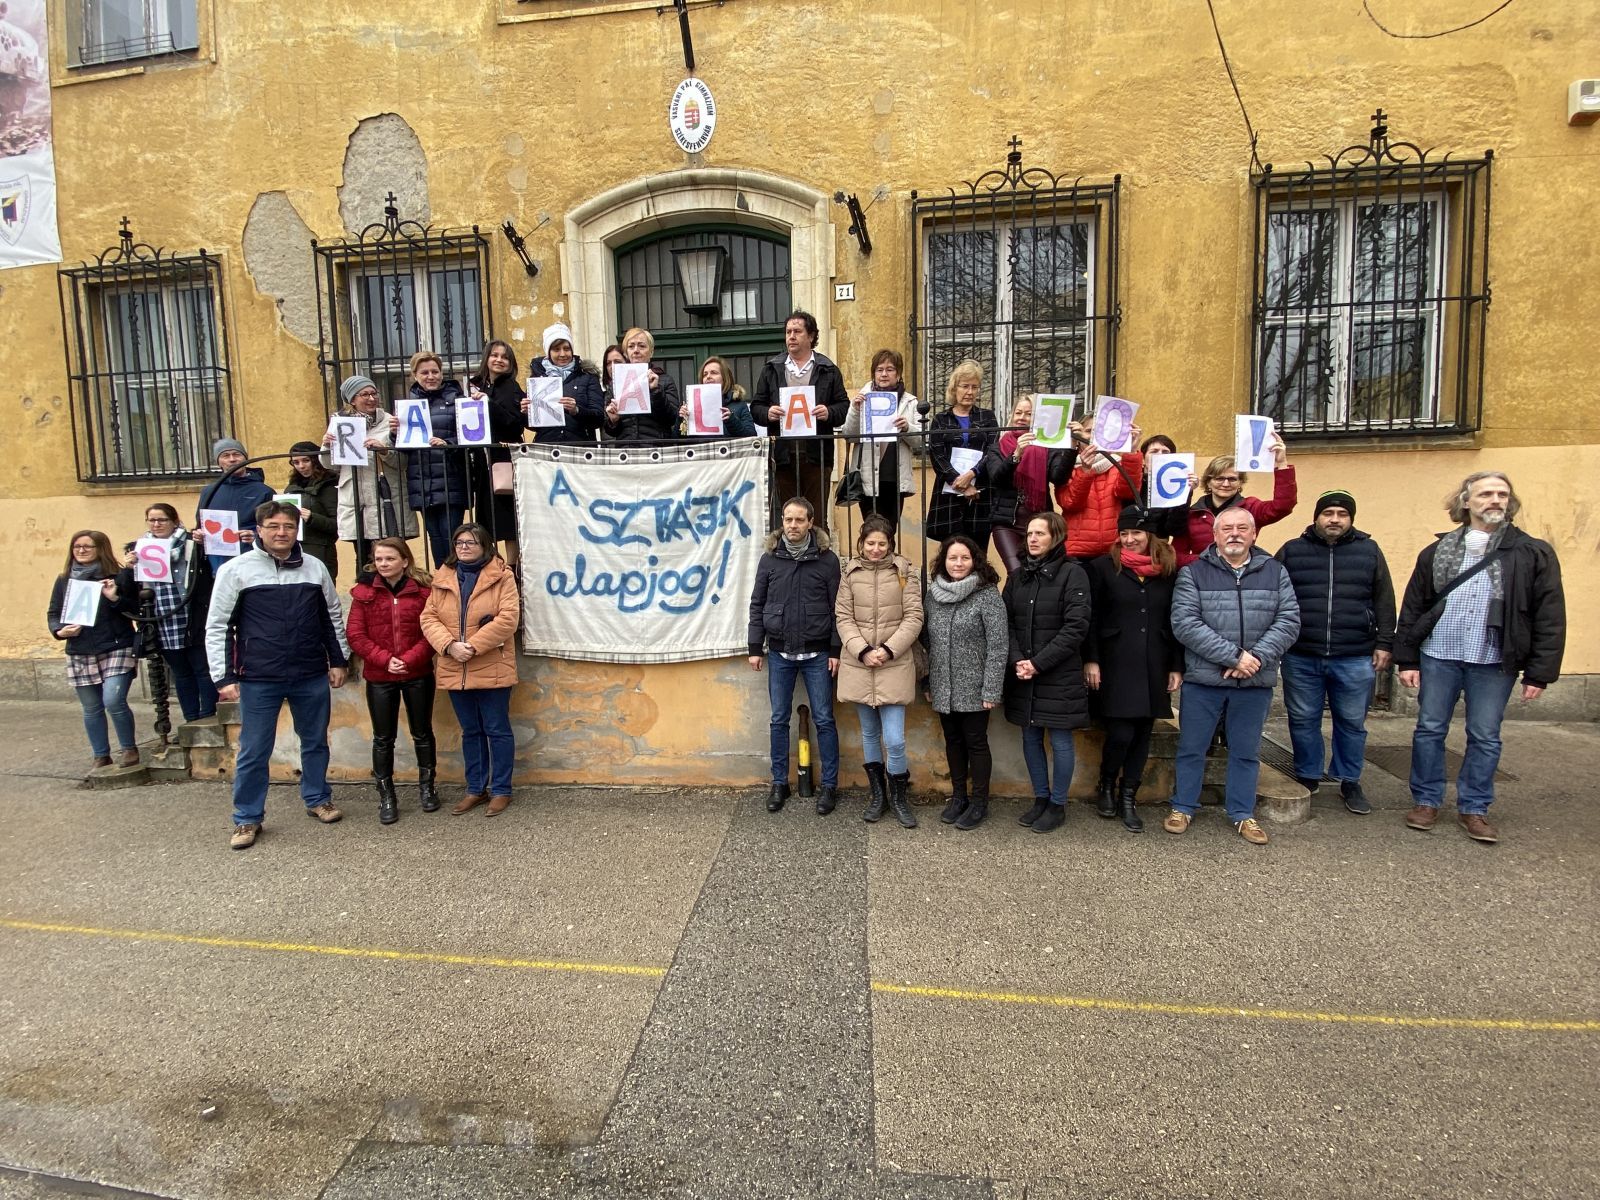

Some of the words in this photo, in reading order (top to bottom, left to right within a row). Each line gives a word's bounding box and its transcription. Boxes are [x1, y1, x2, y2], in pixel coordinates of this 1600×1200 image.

[839, 287, 850, 297] 71
[530, 379, 562, 424] K
[619, 369, 648, 411] A
[461, 401, 486, 442] J
[693, 388, 719, 433] L
[785, 393, 812, 430] A
[865, 392, 897, 440] P
[1037, 398, 1071, 444] J
[337, 422, 364, 460] R
[549, 469, 579, 507] A
[1156, 461, 1188, 499] G
[141, 544, 169, 579] S
[545, 539, 732, 614] alapjog!
[67, 586, 92, 623] A
